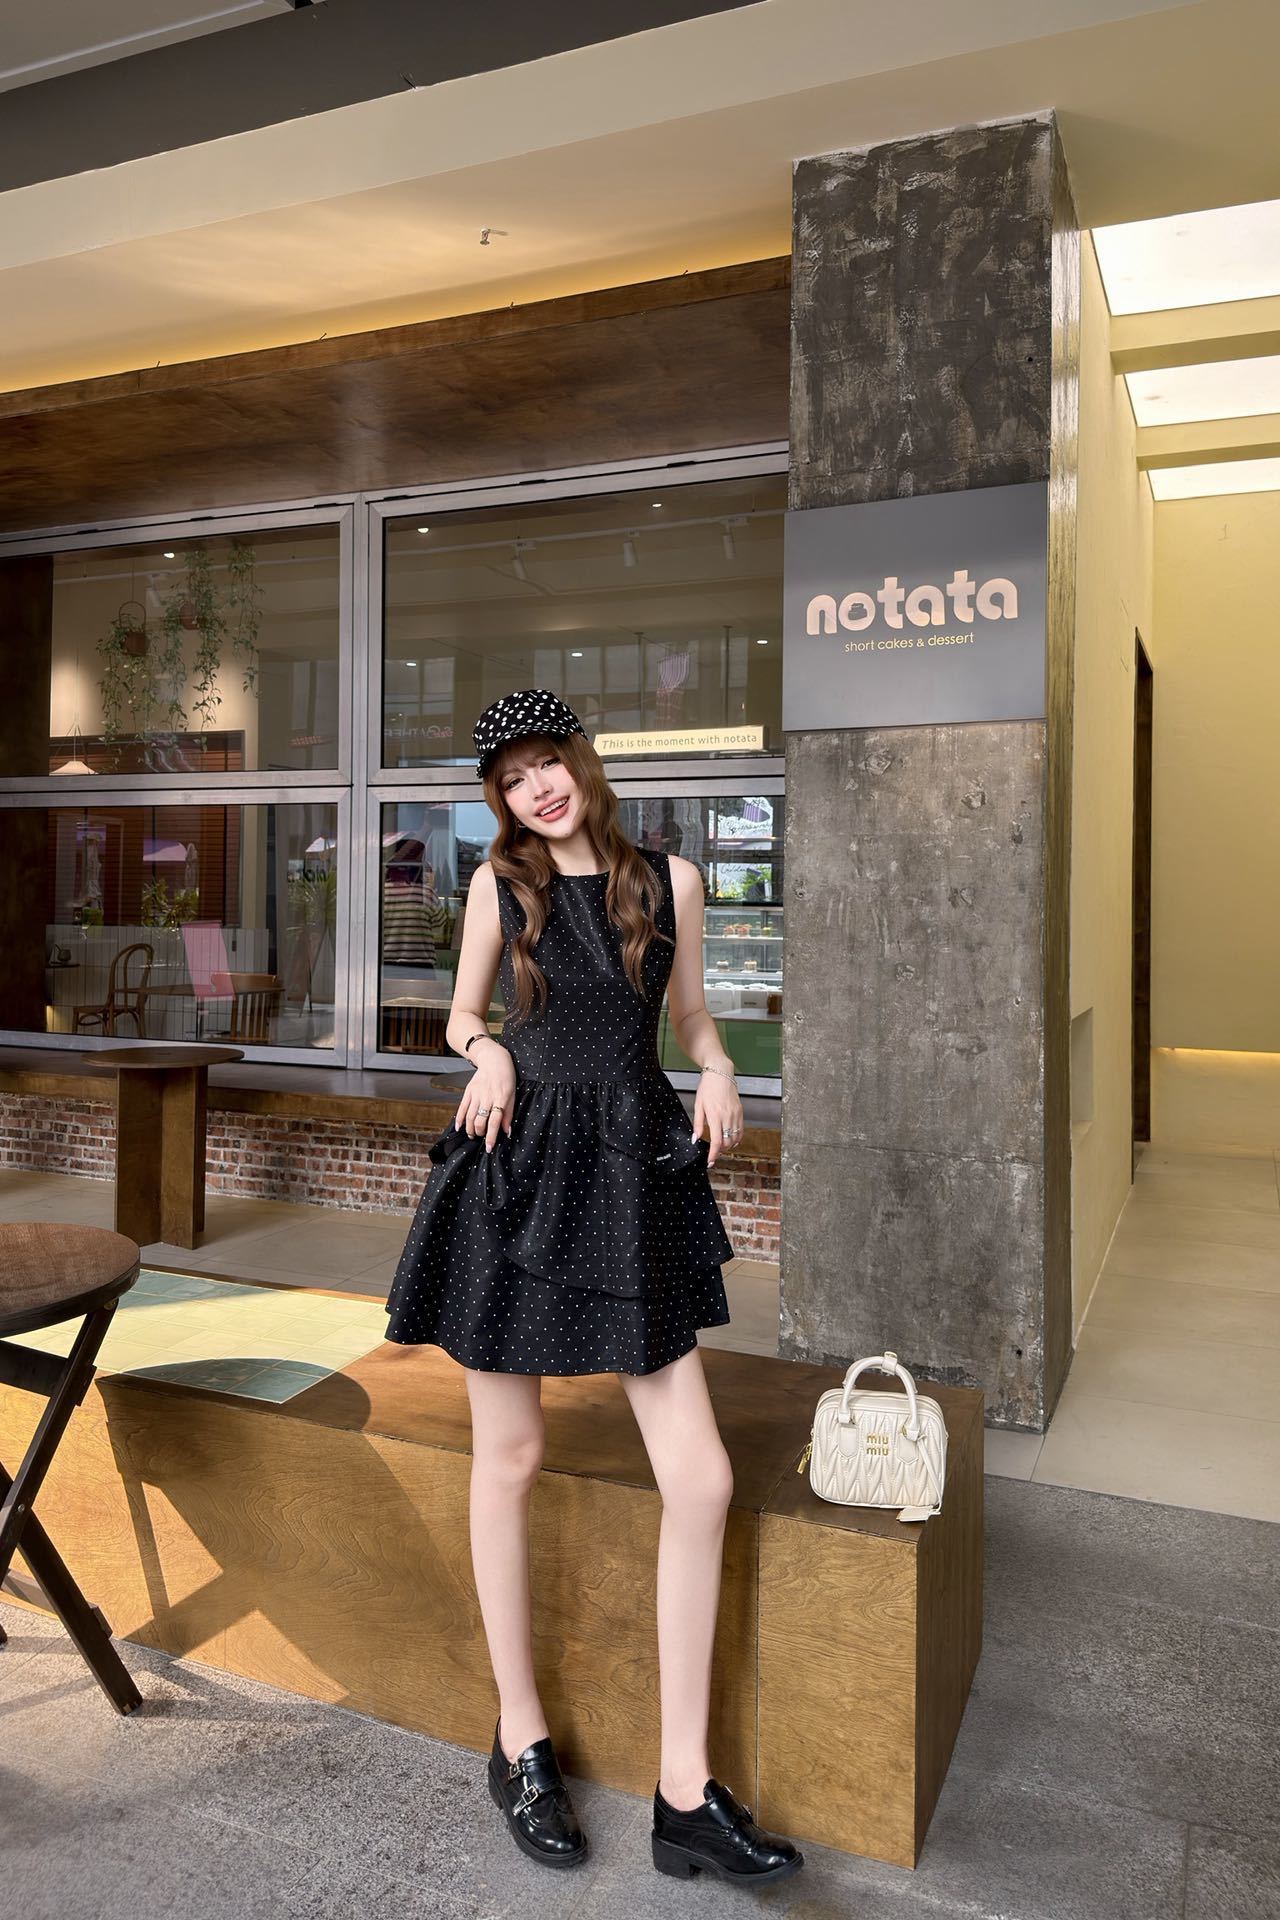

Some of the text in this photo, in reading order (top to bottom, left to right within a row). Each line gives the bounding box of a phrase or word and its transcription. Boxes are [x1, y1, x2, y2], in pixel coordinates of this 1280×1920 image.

[807, 569, 1018, 635] notata
[844, 631, 975, 653] short cakes & dessert
[602, 733, 757, 750] This is the moment with notata
[866, 1434, 889, 1445] miu
[866, 1446, 889, 1456] miu
